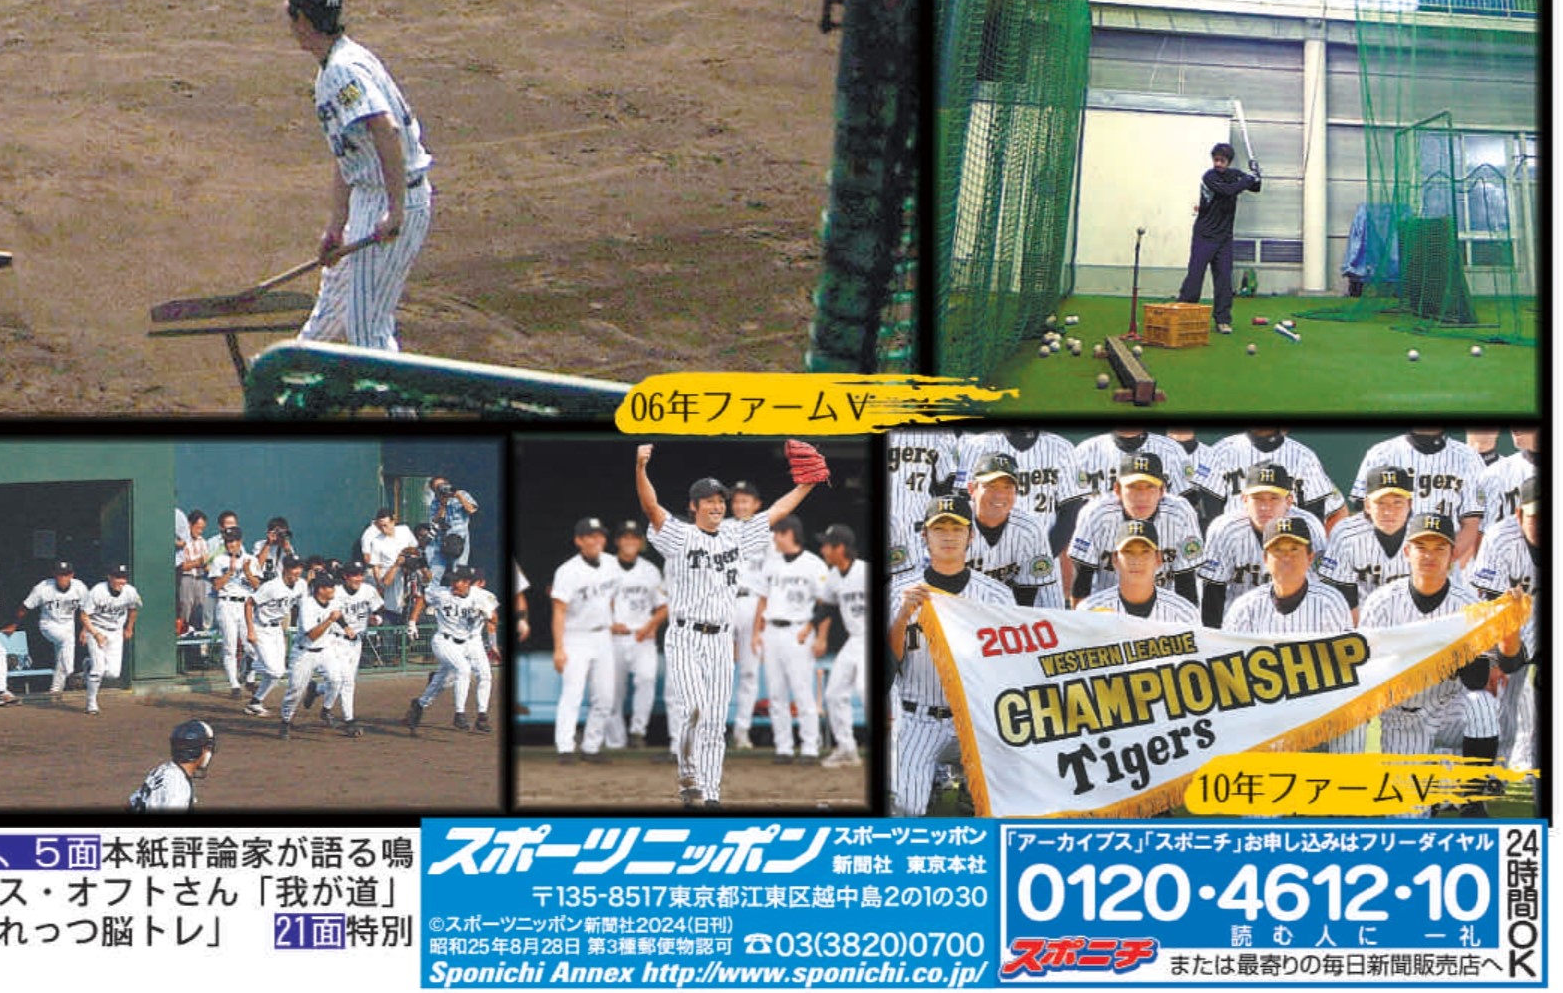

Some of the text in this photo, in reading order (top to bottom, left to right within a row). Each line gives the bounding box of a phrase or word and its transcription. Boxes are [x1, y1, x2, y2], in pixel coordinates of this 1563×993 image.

[905, 471, 927, 492] 47
[977, 619, 1059, 657] 2010
[1039, 631, 1199, 678] WESTERN LEAGUE
[994, 632, 1370, 748] CHAMPIONSHIP
[1057, 717, 1217, 796] Tigers
